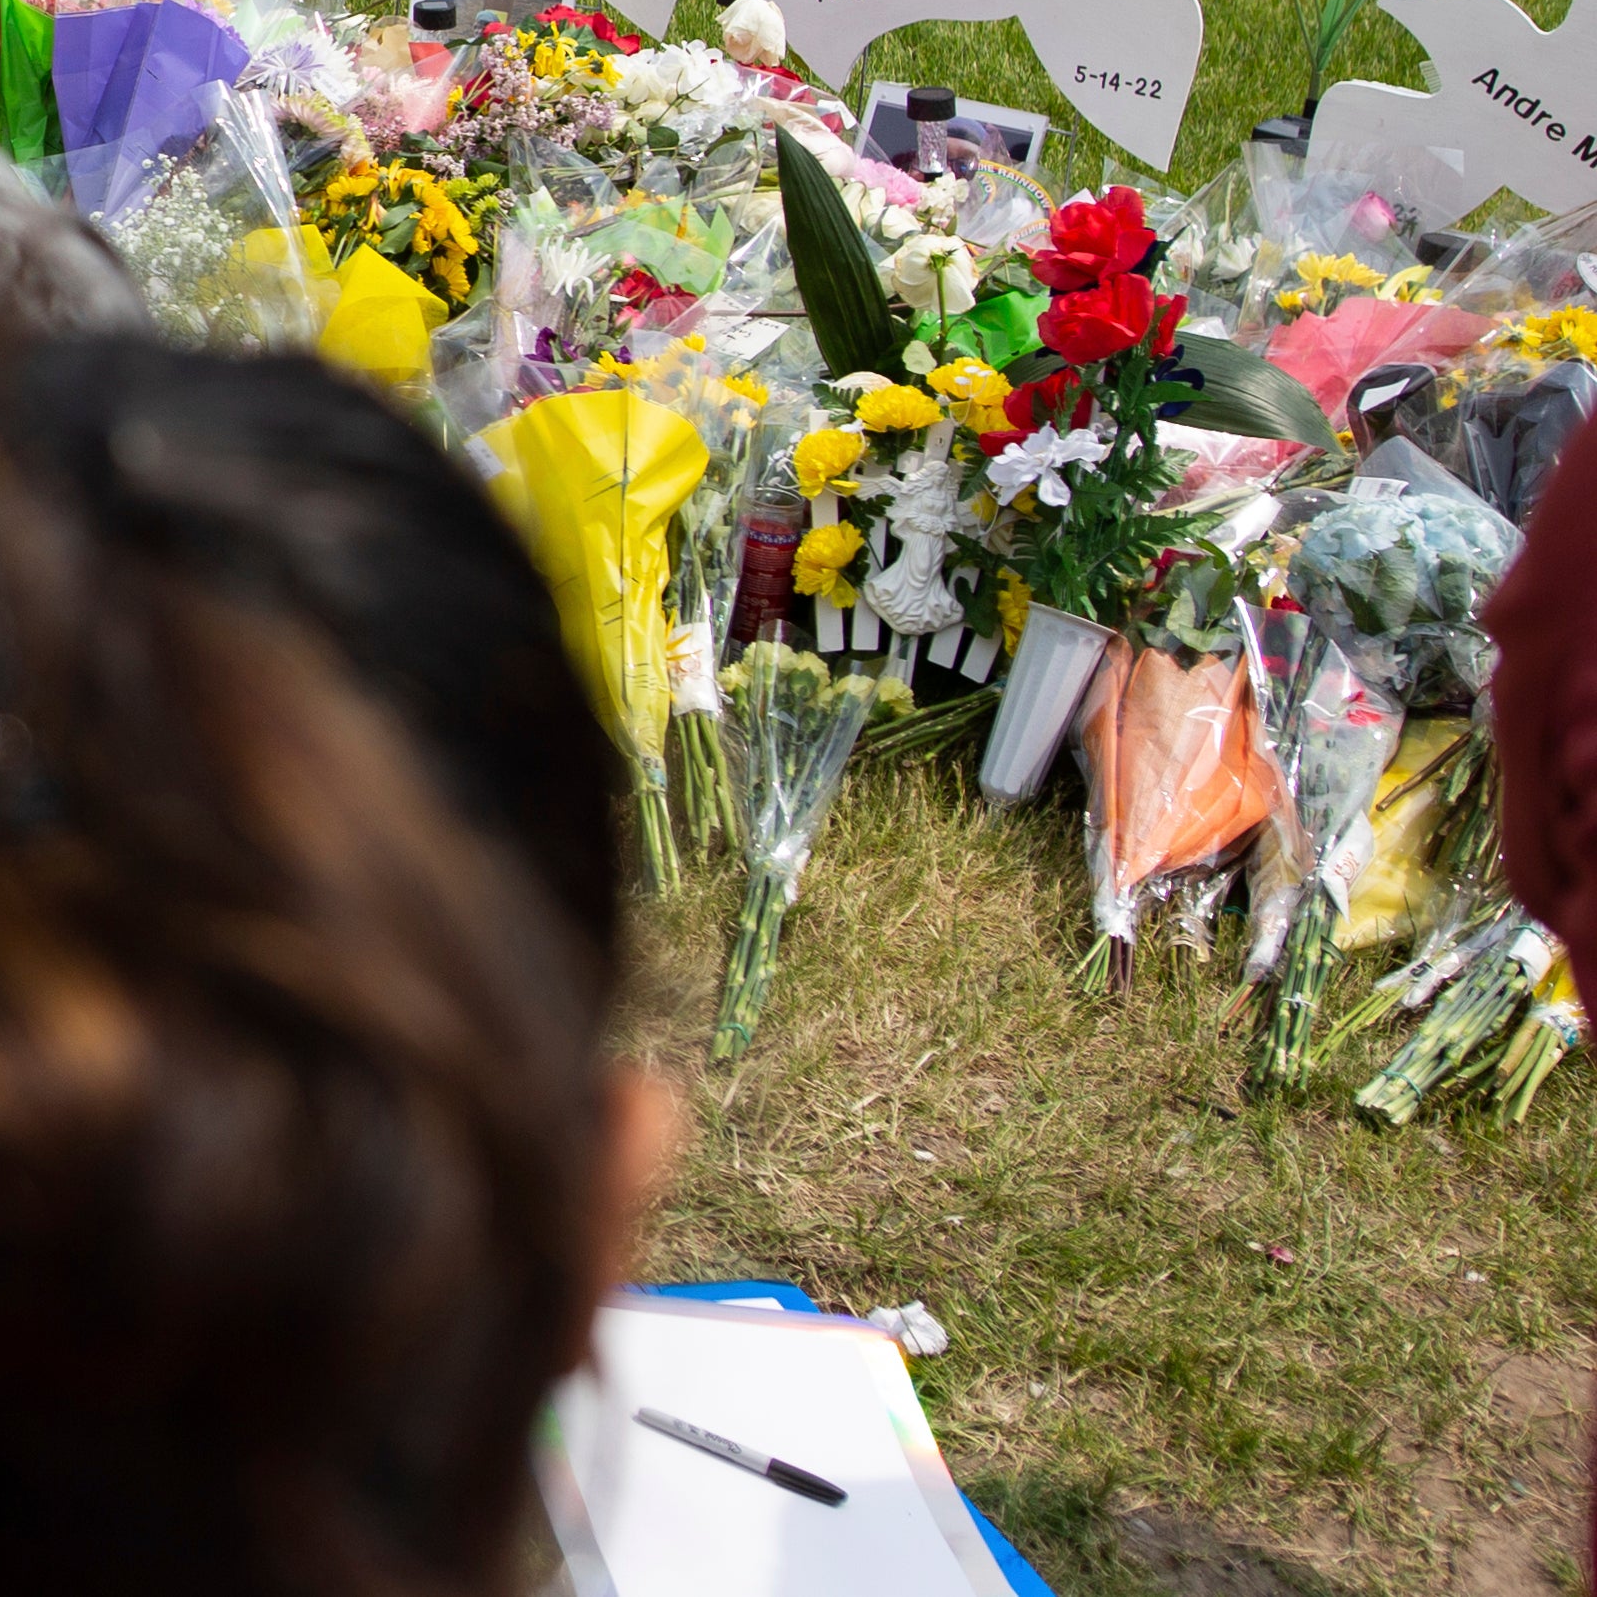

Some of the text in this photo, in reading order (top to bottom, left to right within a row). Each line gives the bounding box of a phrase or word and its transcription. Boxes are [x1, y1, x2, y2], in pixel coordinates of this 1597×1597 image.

[1074, 64, 1164, 101] 5-14-22
[1471, 67, 1567, 142] Andre
[996, 167, 1051, 210] RAINBOW
